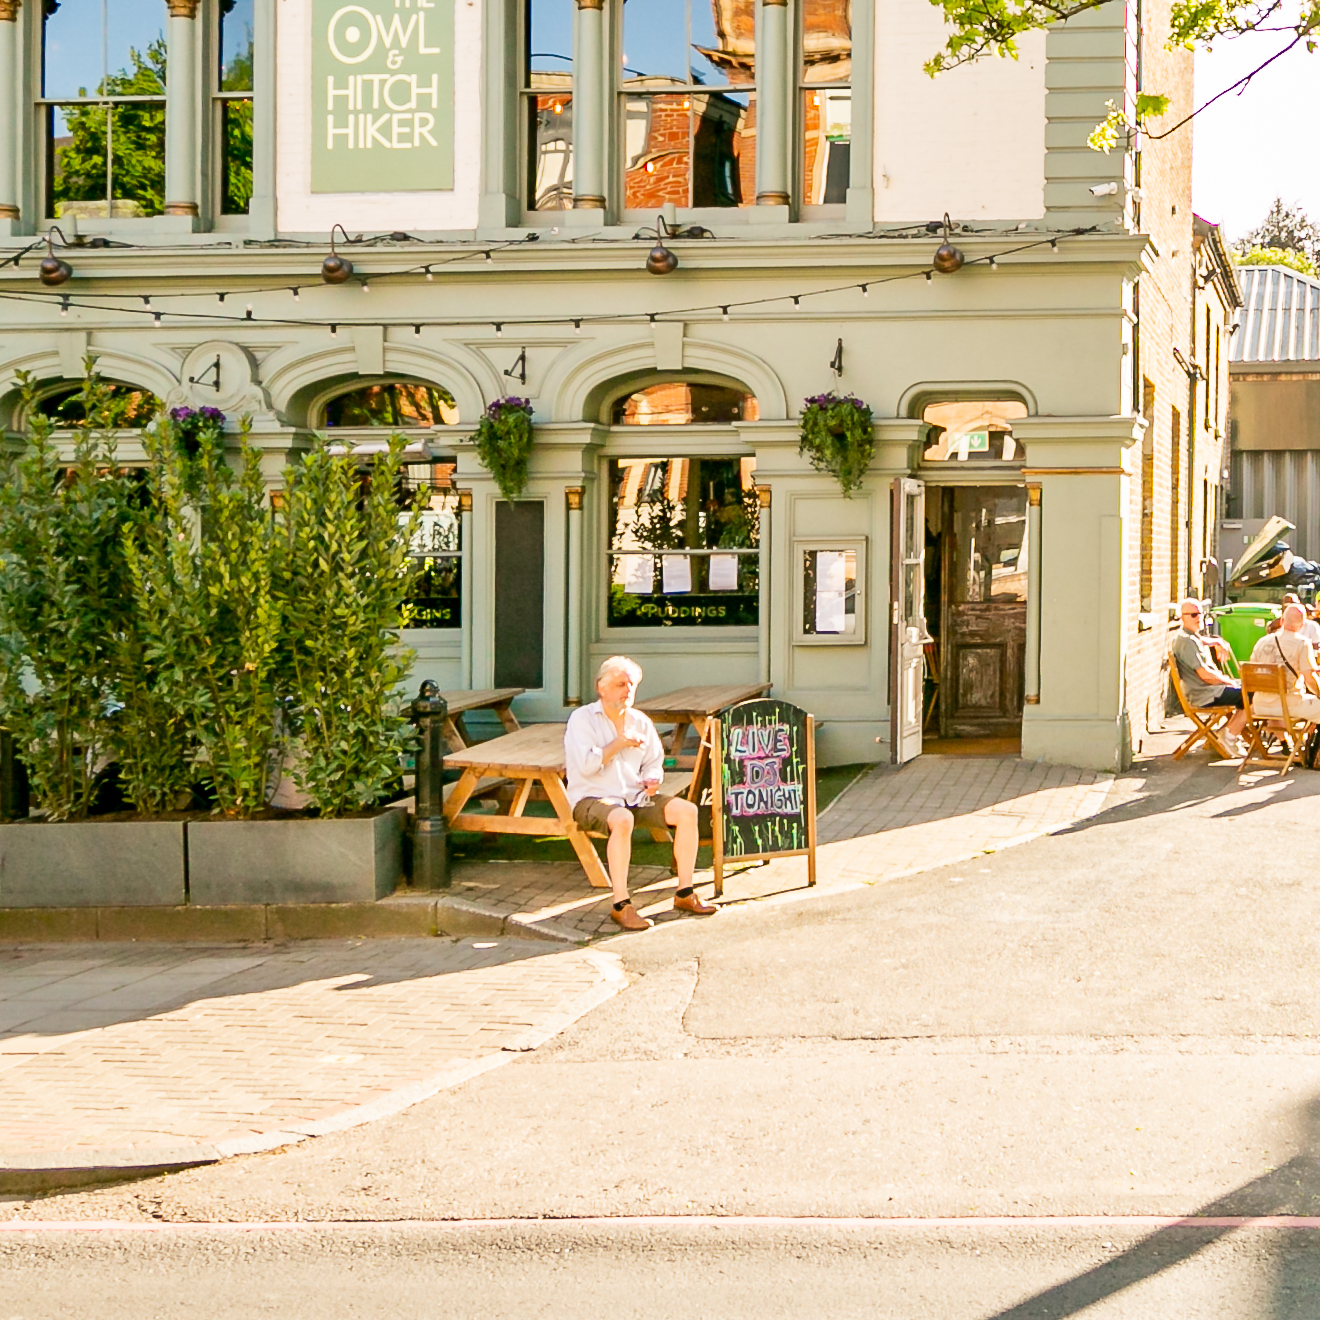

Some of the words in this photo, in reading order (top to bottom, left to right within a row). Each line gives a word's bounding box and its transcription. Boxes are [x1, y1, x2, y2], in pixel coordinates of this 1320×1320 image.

[327, 4, 441, 65] OWL
[386, 49, 404, 70] &
[327, 73, 438, 111] HITCH
[326, 111, 438, 150] HIKER
[731, 726, 790, 758] LIVE
[746, 759, 779, 787] DJ
[729, 785, 803, 816] TONIGHT
